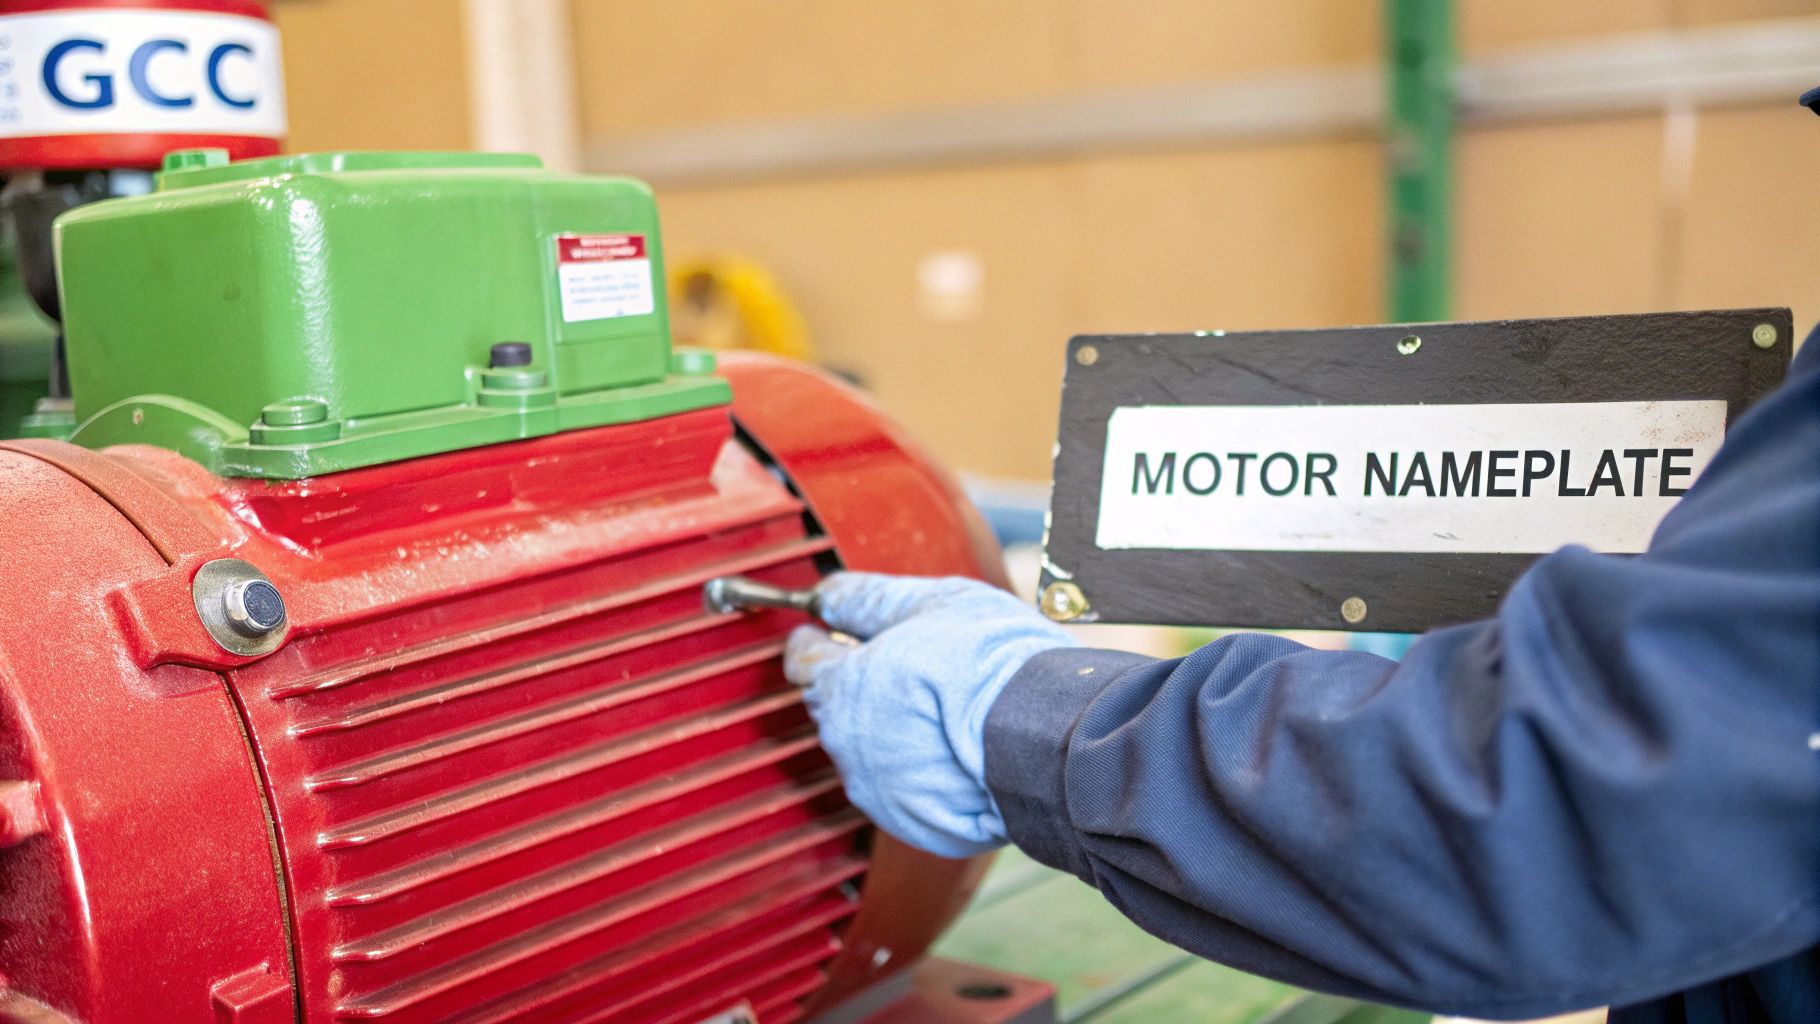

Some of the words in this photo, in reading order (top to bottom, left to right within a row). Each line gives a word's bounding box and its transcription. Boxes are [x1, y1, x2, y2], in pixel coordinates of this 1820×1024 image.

[41, 38, 257, 110] GCC
[1132, 451, 1338, 497] MOTOR
[1362, 448, 1693, 497] NAMEPLATE
